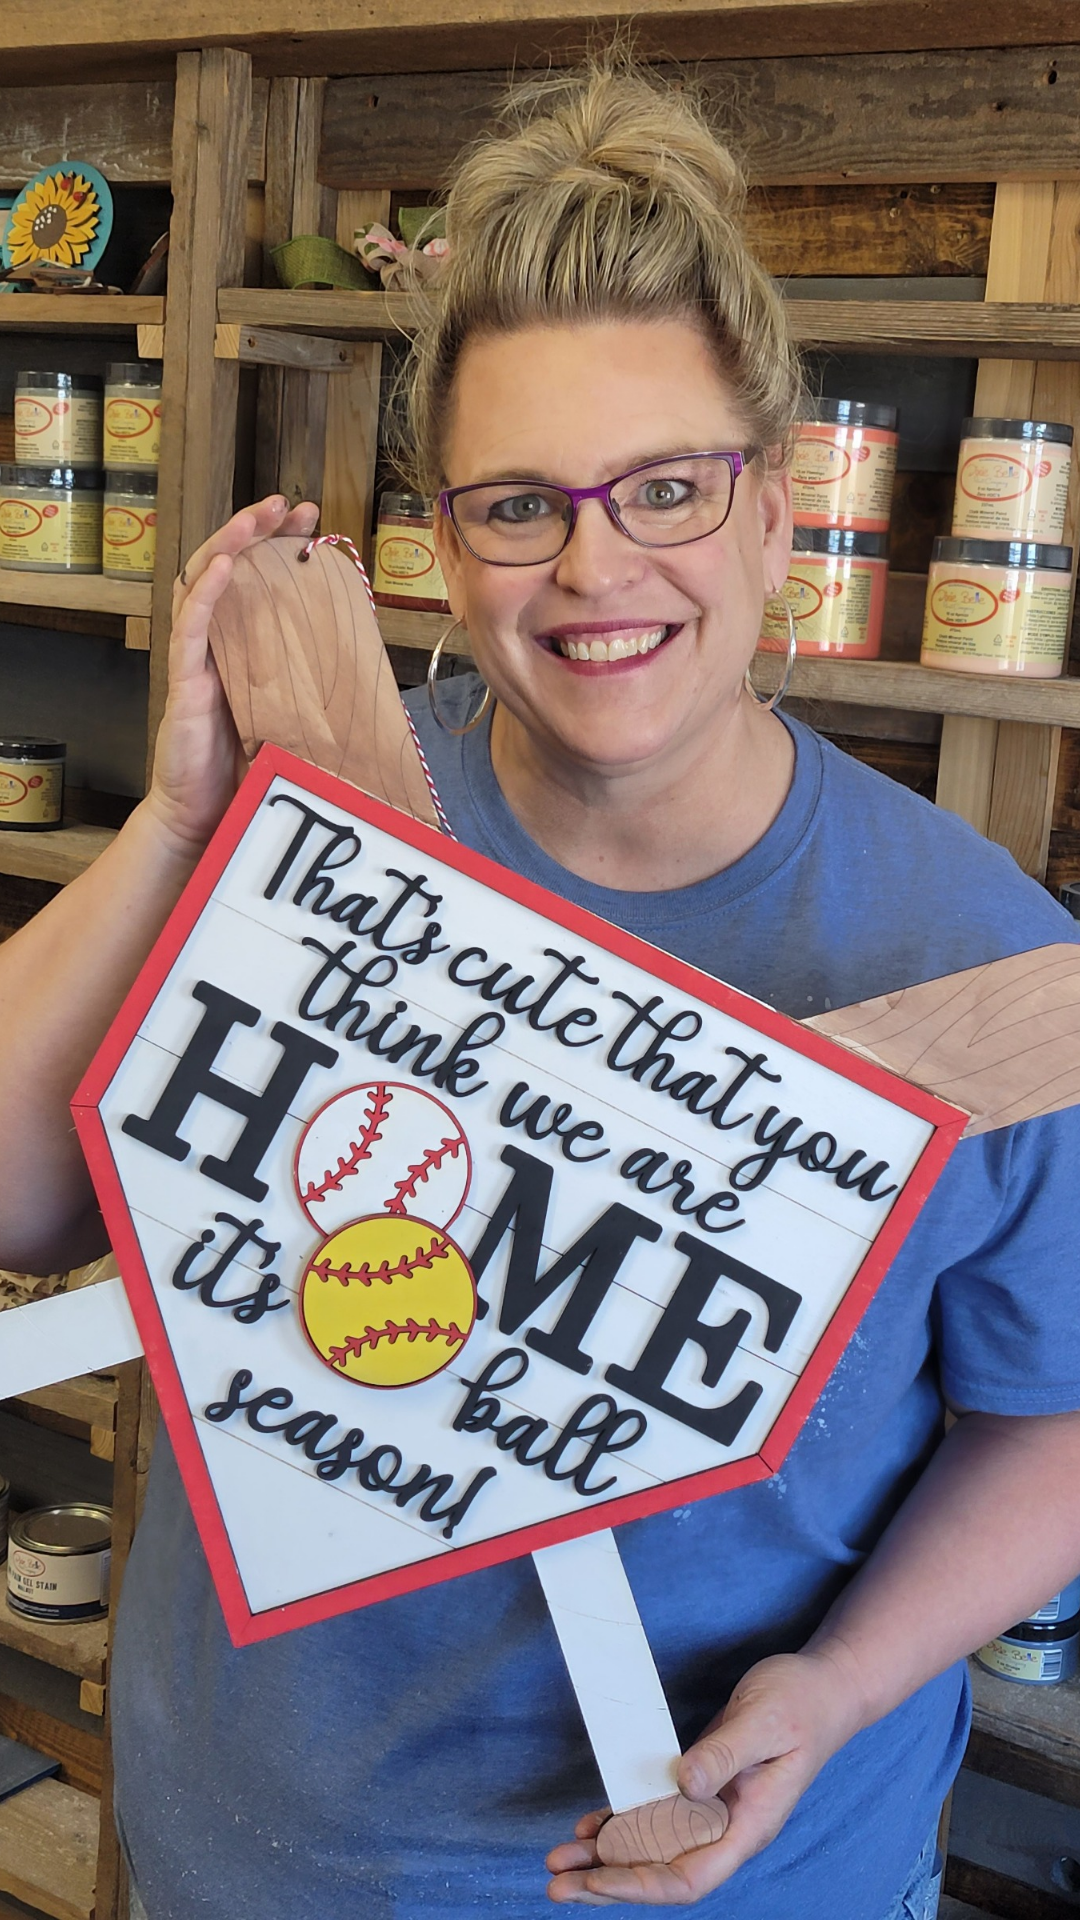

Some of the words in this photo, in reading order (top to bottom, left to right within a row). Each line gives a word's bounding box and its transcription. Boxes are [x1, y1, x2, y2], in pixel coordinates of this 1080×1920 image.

[263, 793, 451, 965] That's
[448, 946, 604, 1048] cute
[607, 990, 782, 1131] that
[729, 1105, 899, 1202] you
[298, 936, 506, 1098] think
[499, 1081, 611, 1163] we
[620, 1147, 746, 1234] are
[171, 1211, 291, 1325] it's
[452, 1346, 648, 1497] ball
[204, 1367, 498, 1540] season!
[22, 1577, 34, 1588] GEL
[35, 1580, 58, 1591] STAIN
